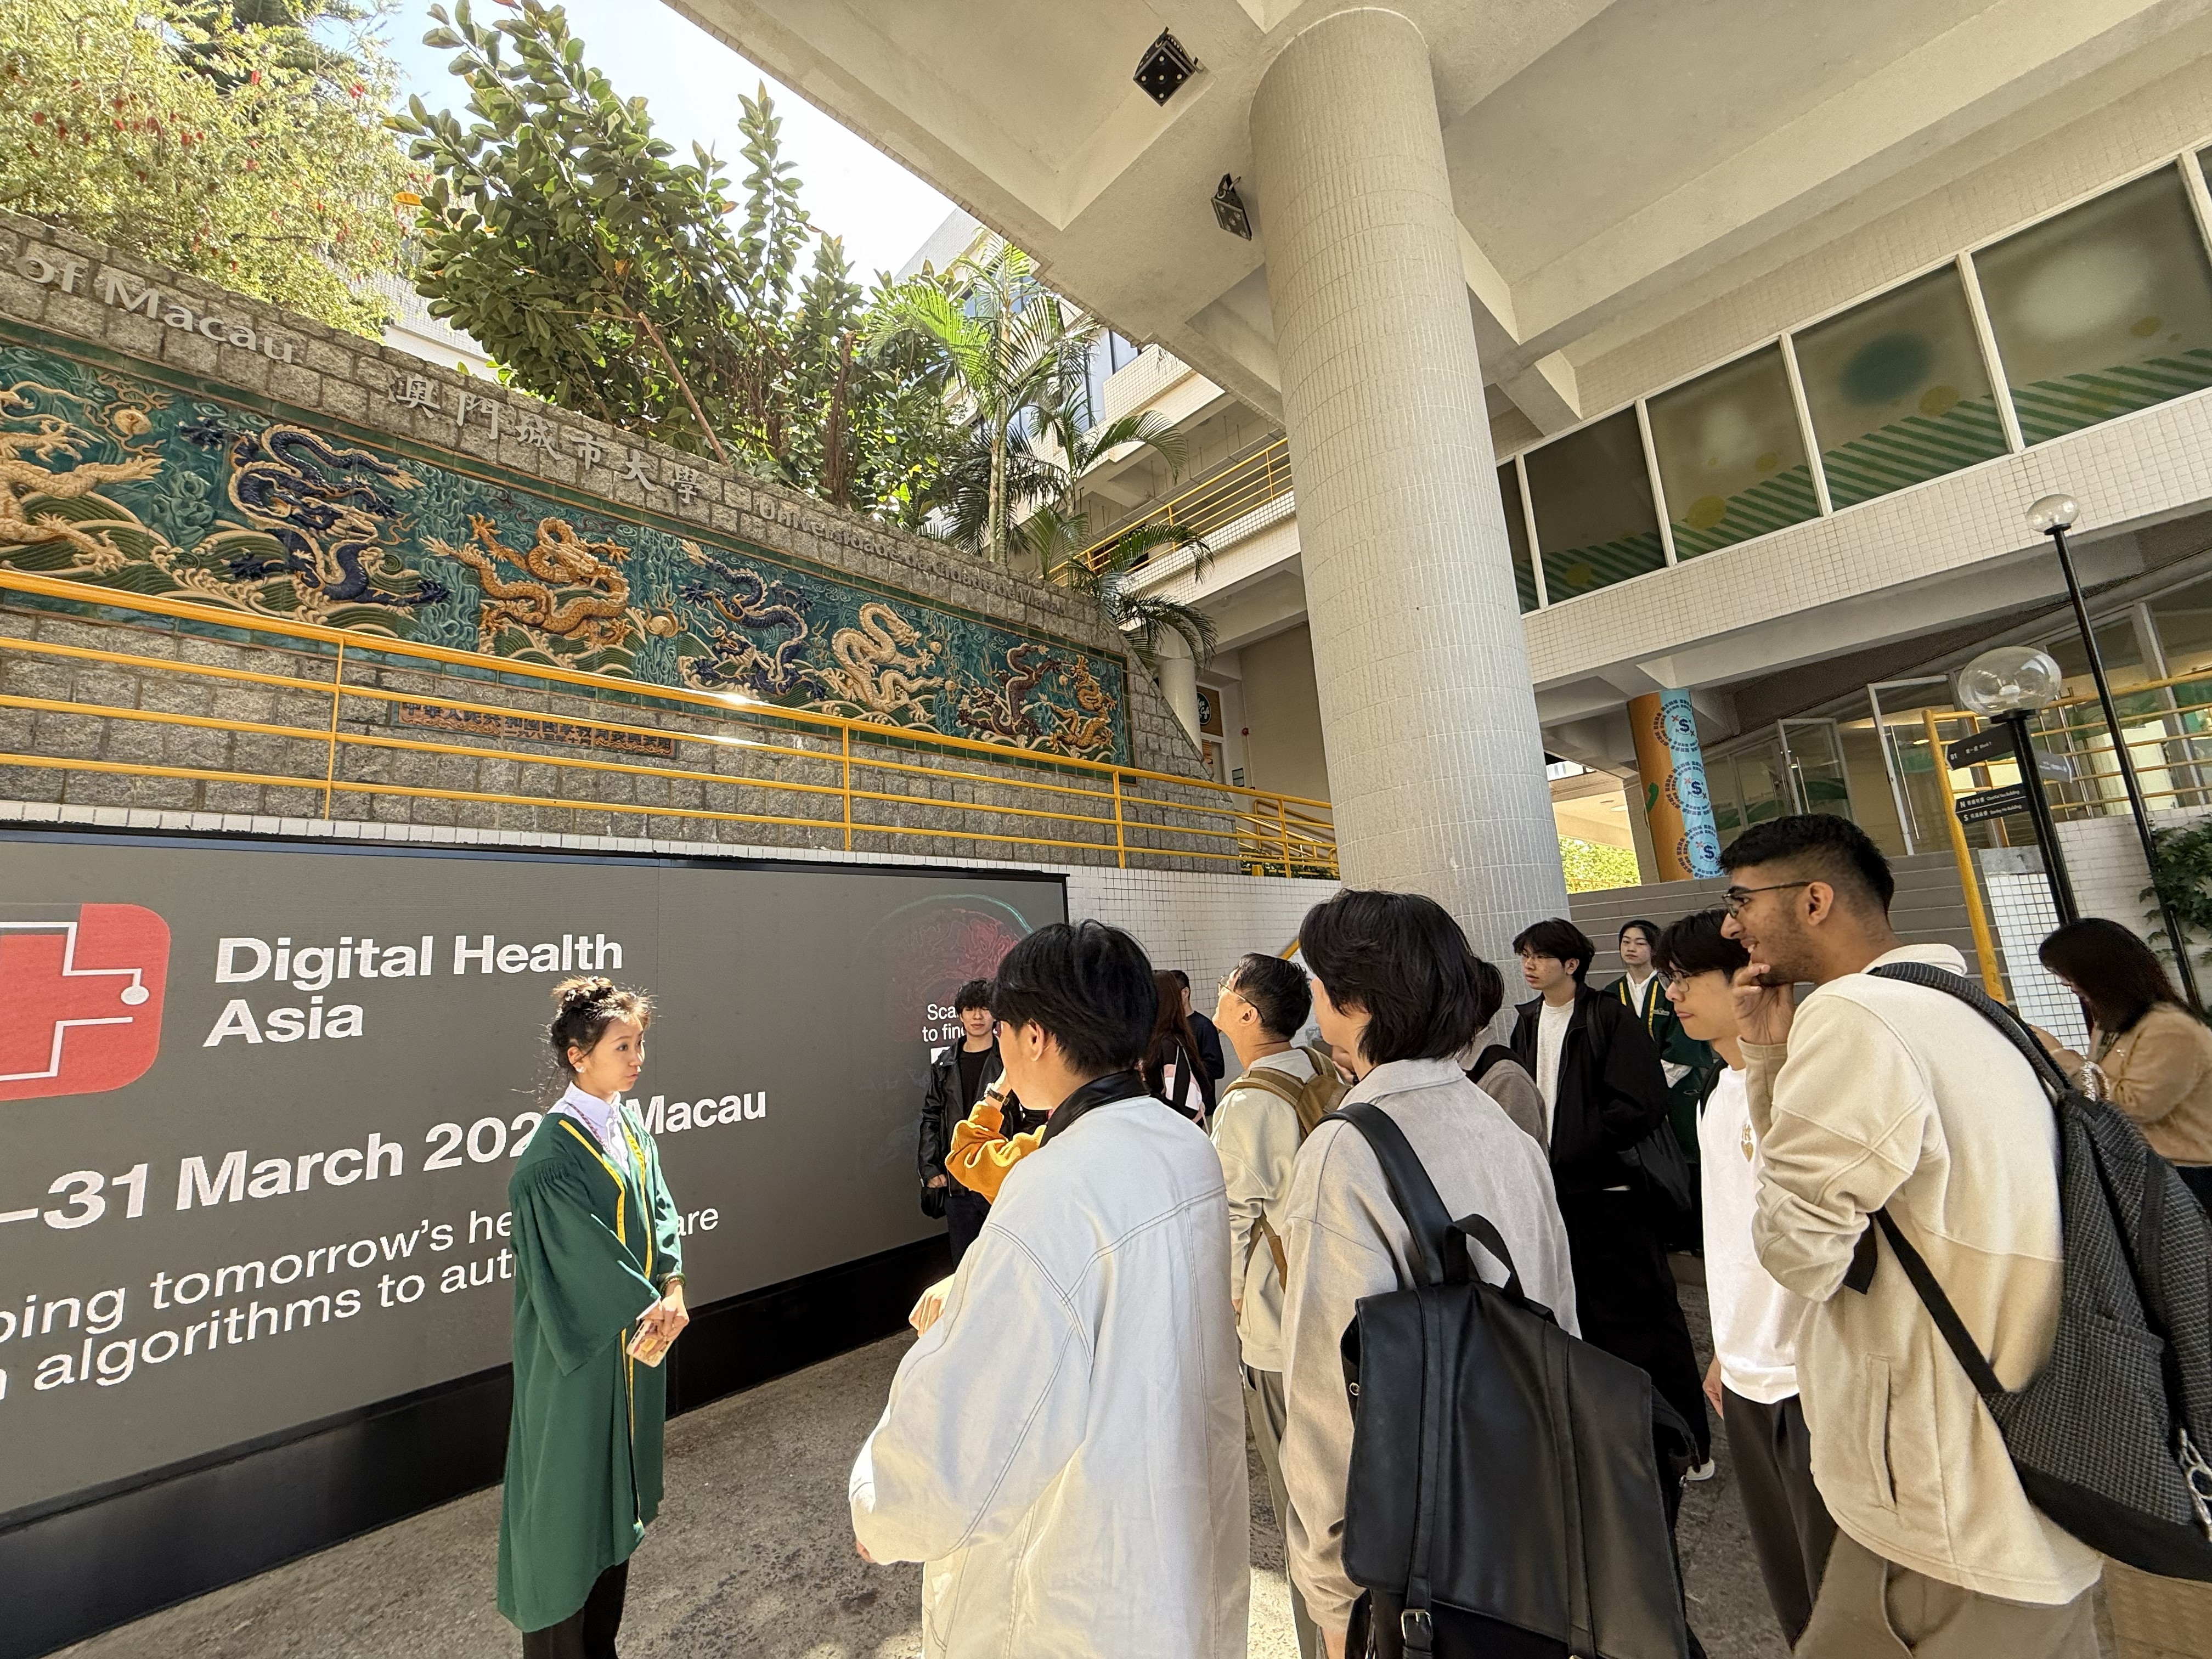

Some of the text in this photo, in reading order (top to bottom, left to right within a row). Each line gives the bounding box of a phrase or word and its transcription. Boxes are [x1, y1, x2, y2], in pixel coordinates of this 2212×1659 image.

[14, 256, 294, 364] of Macau
[388, 369, 703, 504] 澳門城市大學
[759, 498, 900, 561] Universidade
[905, 552, 927, 570] da
[932, 561, 990, 591] Cidade
[996, 582, 1015, 599] de
[215, 934, 622, 991] Digital Health
[927, 1003, 958, 1020] Sca
[202, 995, 363, 1047] Asia
[922, 1026, 938, 1042] to
[176, 1132, 403, 1211] March
[423, 1111, 545, 1172] 202
[625, 1091, 766, 1135] Macau
[34, 1295, 330, 1391] algorithms
[377, 1274, 425, 1307] to
[440, 1248, 516, 1294] aut
